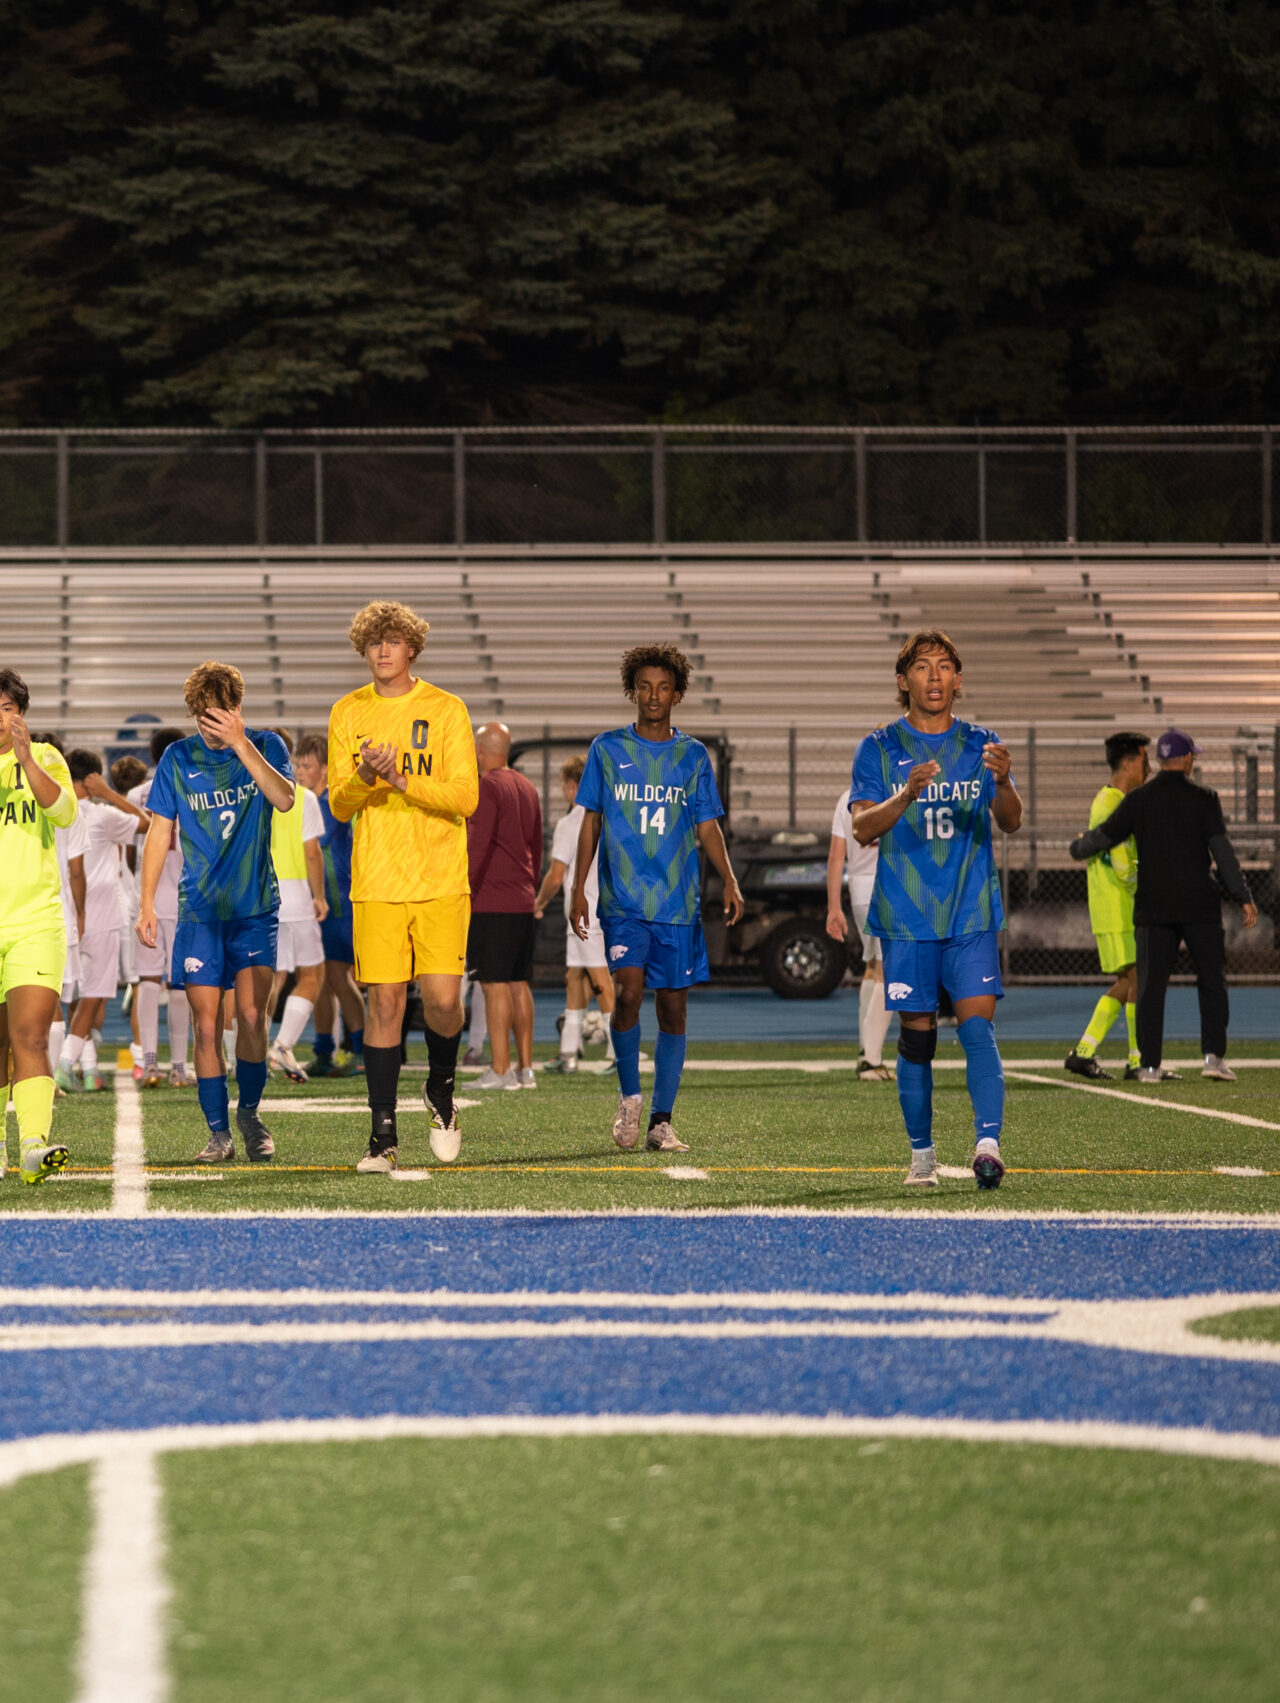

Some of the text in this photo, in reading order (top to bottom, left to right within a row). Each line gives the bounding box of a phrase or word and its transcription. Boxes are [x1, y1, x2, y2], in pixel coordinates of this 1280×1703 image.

[411, 719, 430, 750] 0
[14, 762, 24, 790] 1
[352, 752, 432, 776] EAN
[892, 780, 981, 803] WDCATS
[219, 810, 236, 840] 2
[639, 805, 666, 836] 14
[924, 806, 955, 840] 16
